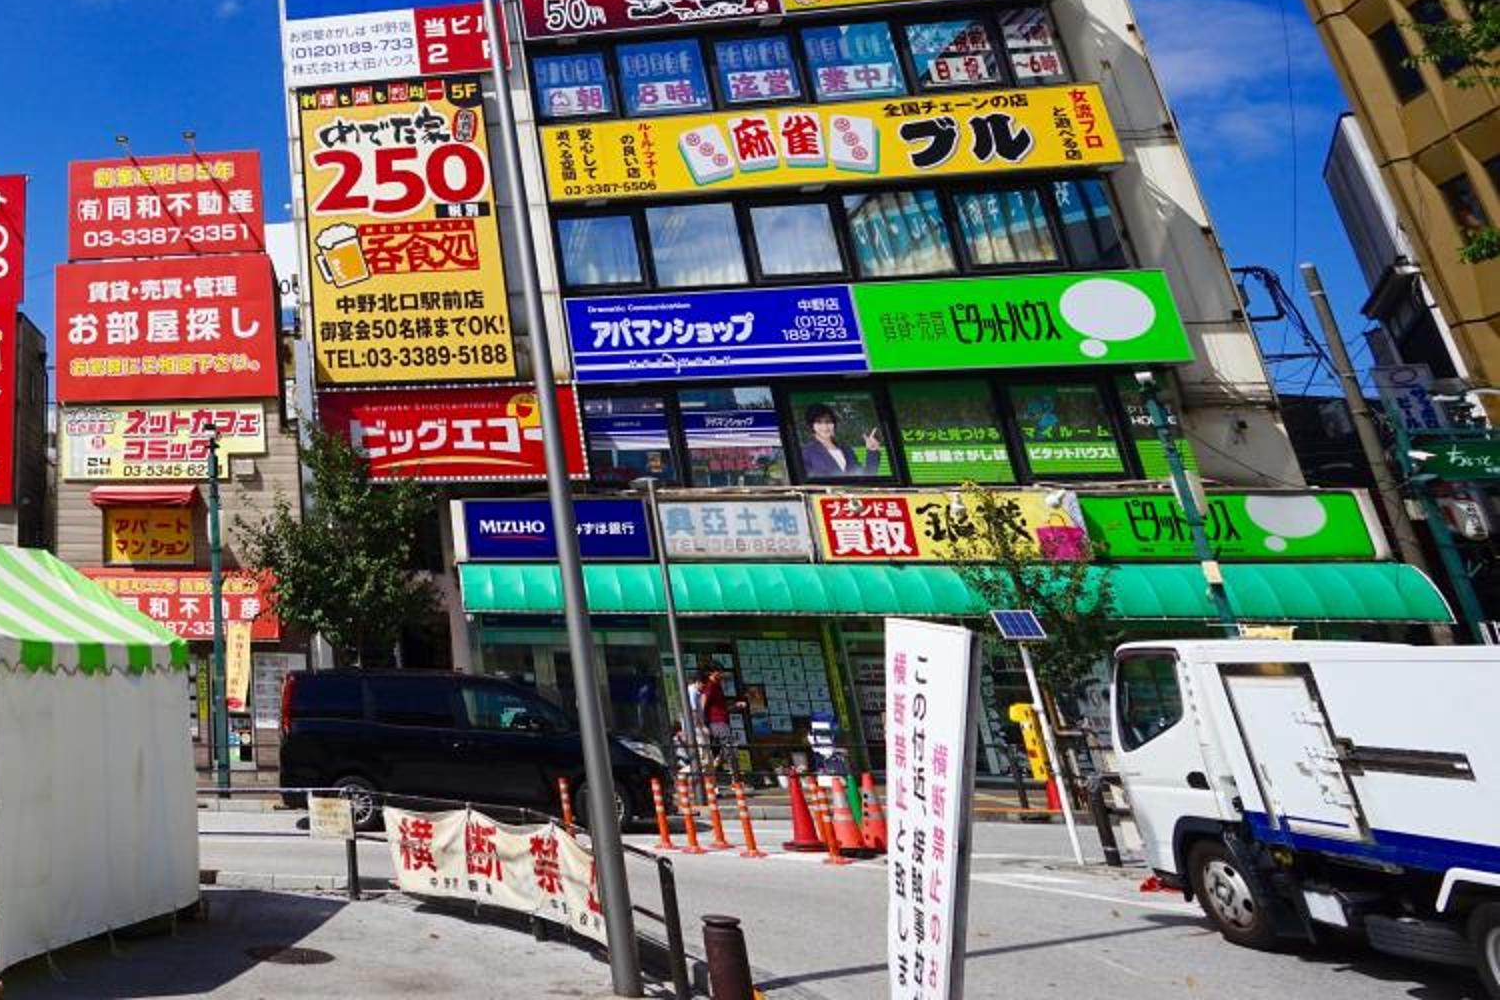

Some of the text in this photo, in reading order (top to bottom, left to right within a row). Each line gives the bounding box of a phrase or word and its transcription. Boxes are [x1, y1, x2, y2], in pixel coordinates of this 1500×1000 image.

[451, 83, 478, 100] 5F
[883, 93, 1029, 117] 全国チェーンの店
[319, 107, 451, 148] めでた家
[733, 115, 821, 160] 麻雀
[900, 112, 1033, 168] ブル
[1052, 106, 1083, 161] と遊べる店
[577, 128, 598, 180] 安心して
[620, 134, 641, 179] の良い店
[313, 143, 485, 215] 250
[83, 223, 250, 248] 03-3387-3351
[88, 275, 238, 304] 賃貸・売買・管理
[336, 289, 485, 315] 中野北口駅前店
[797, 298, 840, 313] 中野店
[67, 306, 260, 345] お部屋探し
[320, 315, 506, 343] 御宴会50名様までOK!
[590, 312, 755, 348] アパマンショップ
[795, 315, 845, 329] (0120)
[949, 299, 1063, 346] ピタットハウス
[123, 409, 261, 437] ネットカフェ
[123, 439, 212, 462] コミック
[115, 517, 190, 536] アパート
[478, 519, 546, 535] MIZUHO
[830, 519, 913, 555] 買取
[115, 538, 191, 556] マンション
